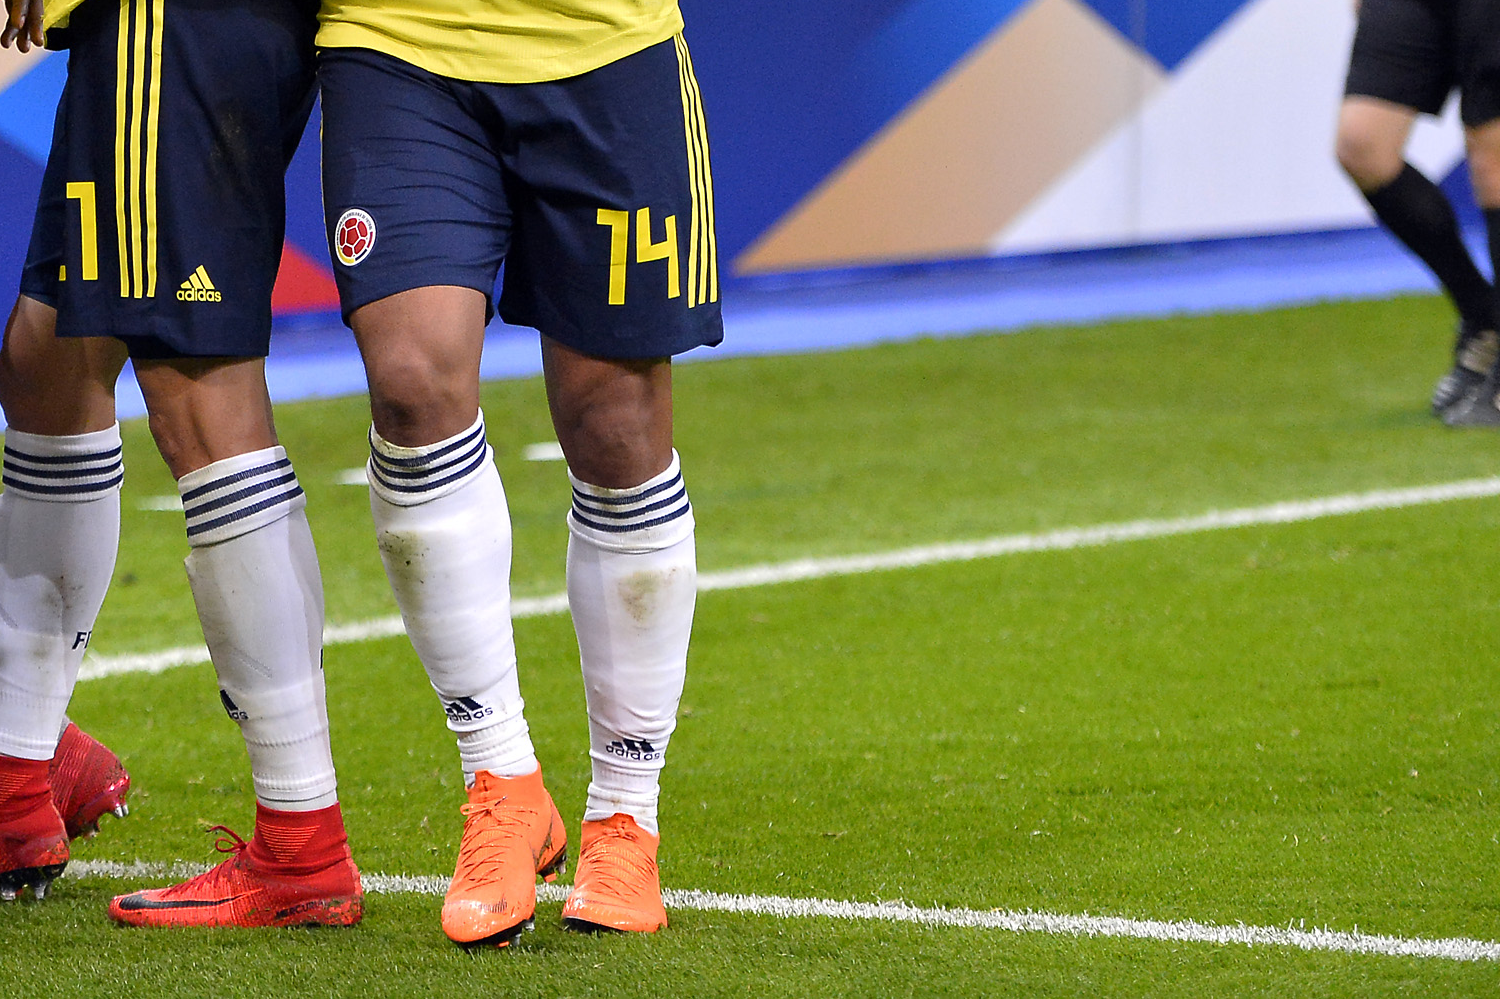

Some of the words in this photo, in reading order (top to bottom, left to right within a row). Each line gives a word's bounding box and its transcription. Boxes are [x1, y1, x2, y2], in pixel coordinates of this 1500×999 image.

[596, 207, 681, 306] 14
[176, 287, 222, 302] adidas
[605, 744, 660, 761] adidas
